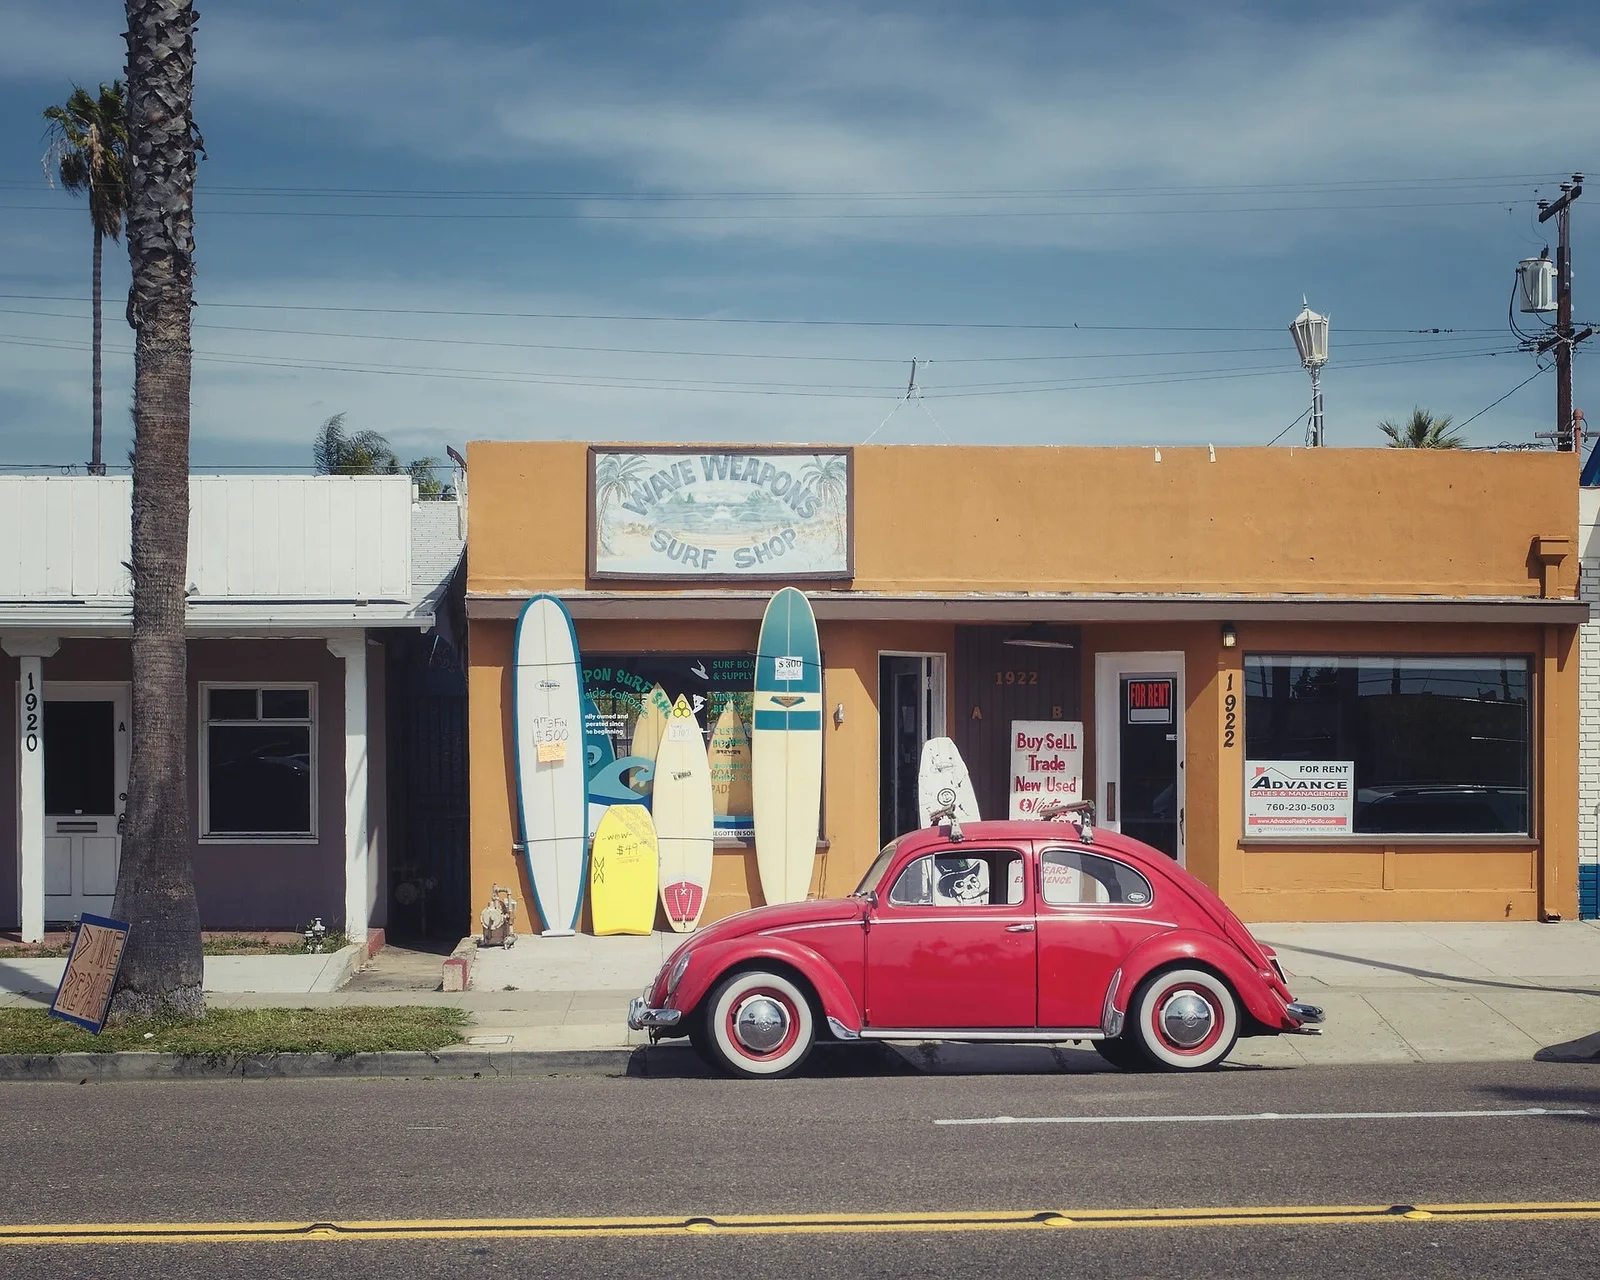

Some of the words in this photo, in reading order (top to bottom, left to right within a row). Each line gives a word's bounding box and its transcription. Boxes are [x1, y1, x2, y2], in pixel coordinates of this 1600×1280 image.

[621, 459, 697, 516] WAVE
[700, 455, 821, 519] WEAPONS
[650, 530, 717, 569] SURF
[733, 528, 797, 569] SHOP
[712, 660, 735, 669] SURF
[737, 660, 755, 669] BOA
[581, 667, 612, 683] PON
[713, 672, 720, 680] &
[721, 672, 754, 680] SUPPLY
[994, 671, 1038, 685] 1922
[583, 687, 606, 700] side
[1130, 683, 1146, 707] FOR
[1148, 683, 1170, 707] RENT
[25, 672, 38, 752] 1920
[972, 706, 982, 719] A
[1053, 706, 1063, 719] B
[1223, 673, 1237, 748] 1922
[118, 721, 126, 732] A
[1016, 732, 1044, 751] Buy
[1028, 755, 1065, 771] Trade
[1300, 765, 1319, 773] FOR
[1322, 765, 1348, 773] RENT
[1015, 776, 1041, 791] New
[1047, 776, 1076, 792] Used
[1252, 776, 1347, 789] ADVANCE
[1266, 803, 1335, 811] 760-230-5003
[1043, 866, 1069, 875] EARS
